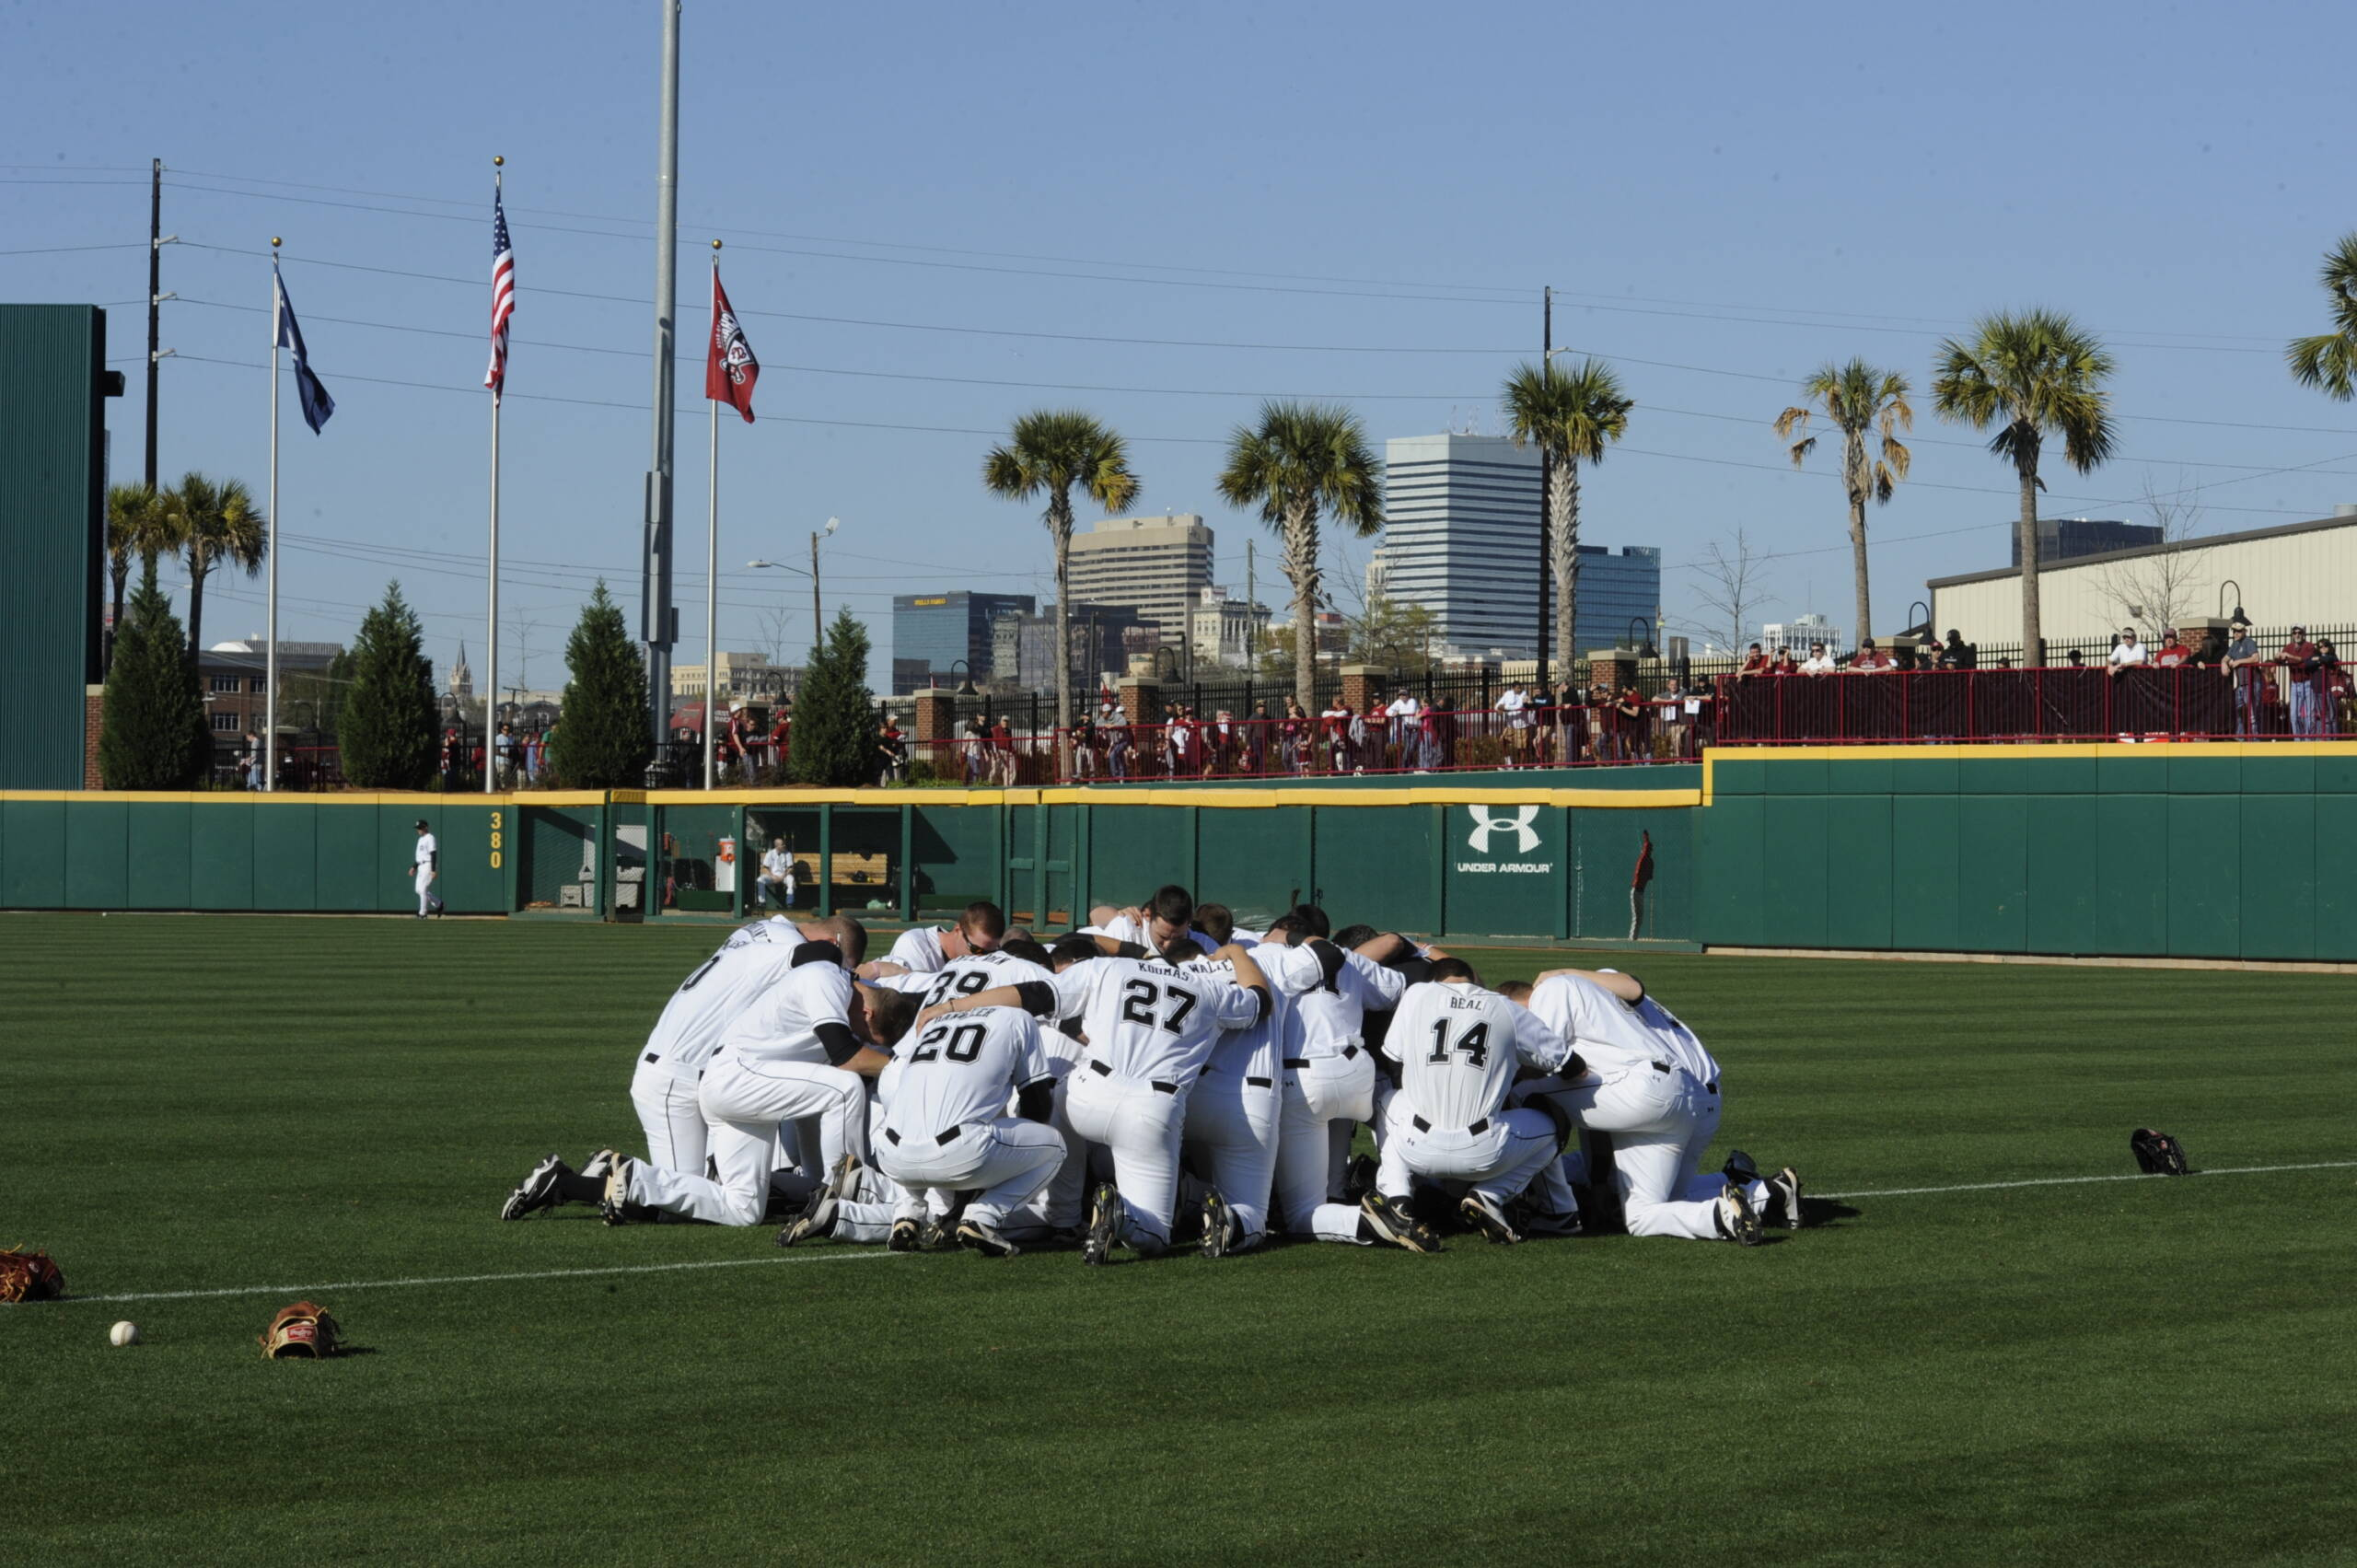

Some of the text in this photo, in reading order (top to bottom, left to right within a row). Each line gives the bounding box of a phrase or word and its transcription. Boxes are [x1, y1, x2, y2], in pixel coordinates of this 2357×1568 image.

[491, 811, 501, 868] 380
[1457, 863, 1550, 874] UNDER ARMOUR
[1138, 962, 1190, 981] KOUMAS
[1120, 978, 1197, 1038] 27
[1450, 996, 1481, 1011] BEAL
[908, 1023, 989, 1065] 20
[1427, 1016, 1491, 1071] 14
